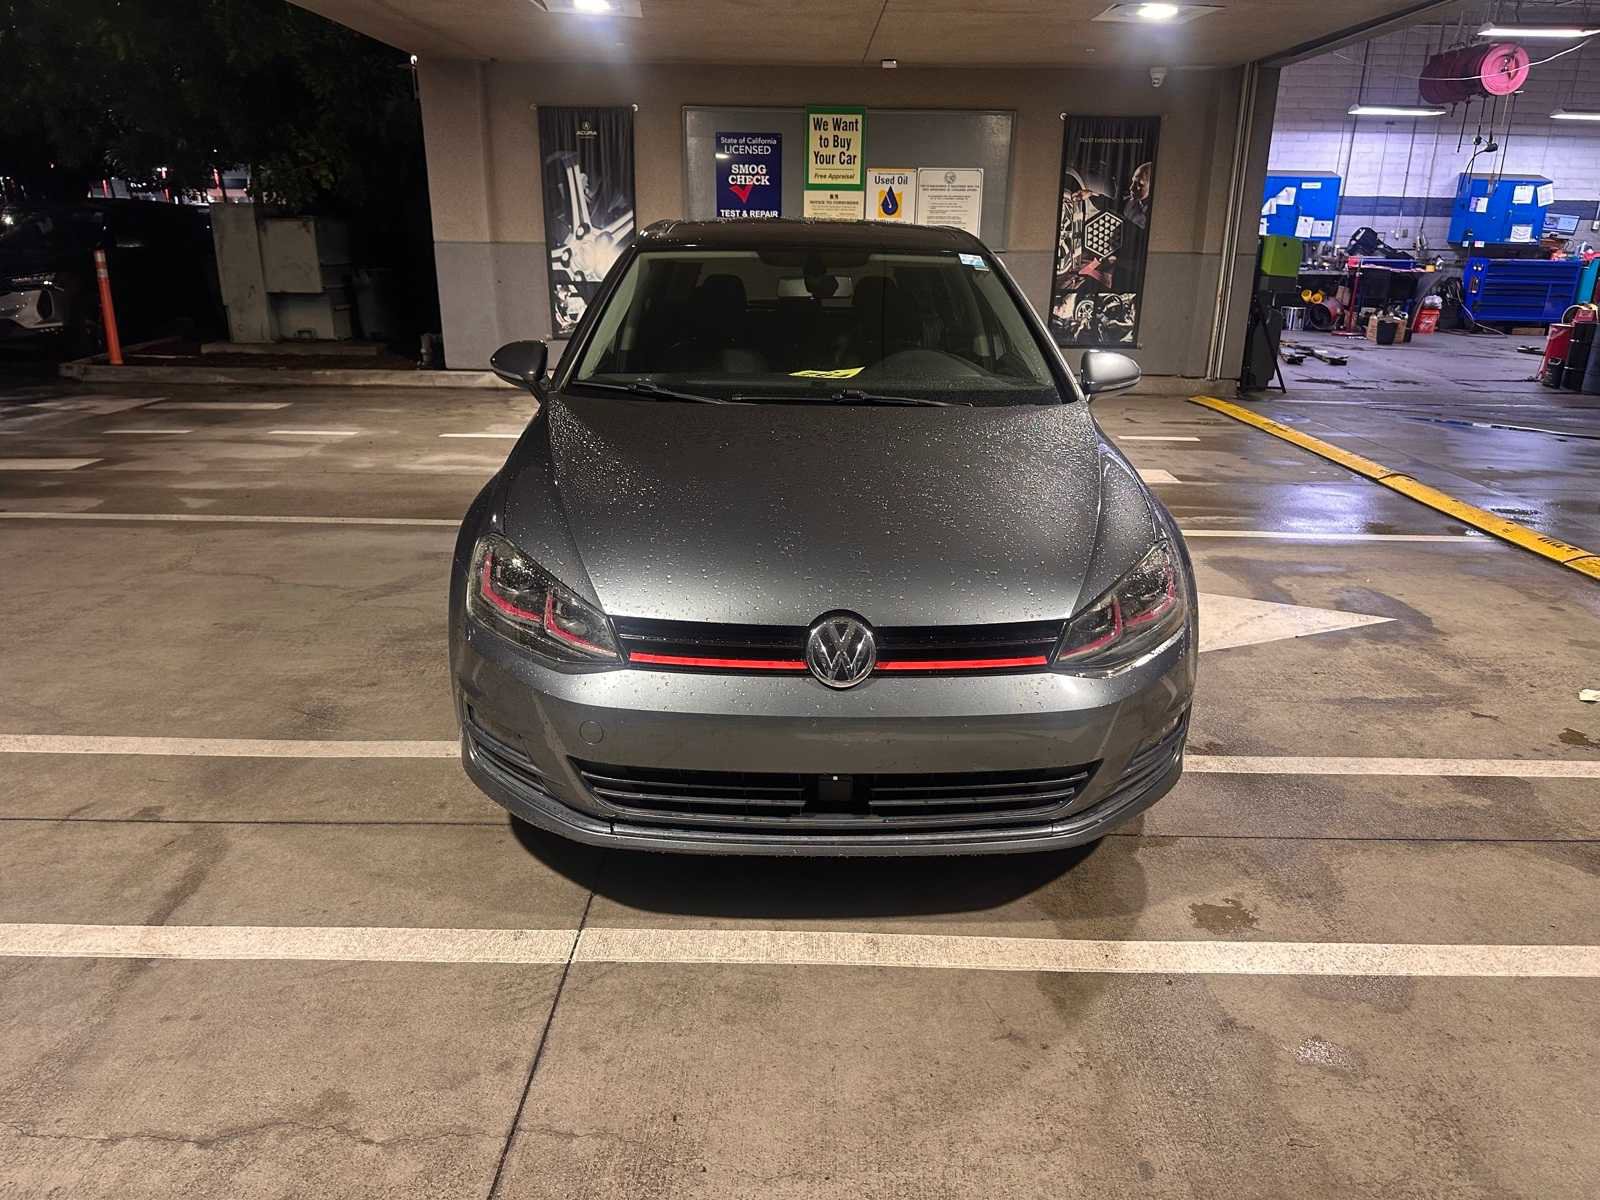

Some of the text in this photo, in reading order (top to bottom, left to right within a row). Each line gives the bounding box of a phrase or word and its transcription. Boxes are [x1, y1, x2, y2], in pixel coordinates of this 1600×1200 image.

[812, 117, 859, 132] We Want
[720, 136, 777, 145] State of California
[819, 134, 852, 151] to Buy
[724, 145, 772, 155] LICENSED
[813, 151, 857, 165] Your Car
[731, 164, 767, 175] SMOG
[728, 175, 770, 186] CHECK
[874, 175, 909, 185] Used Oil
[720, 209, 779, 218] TEST & REPAIR
